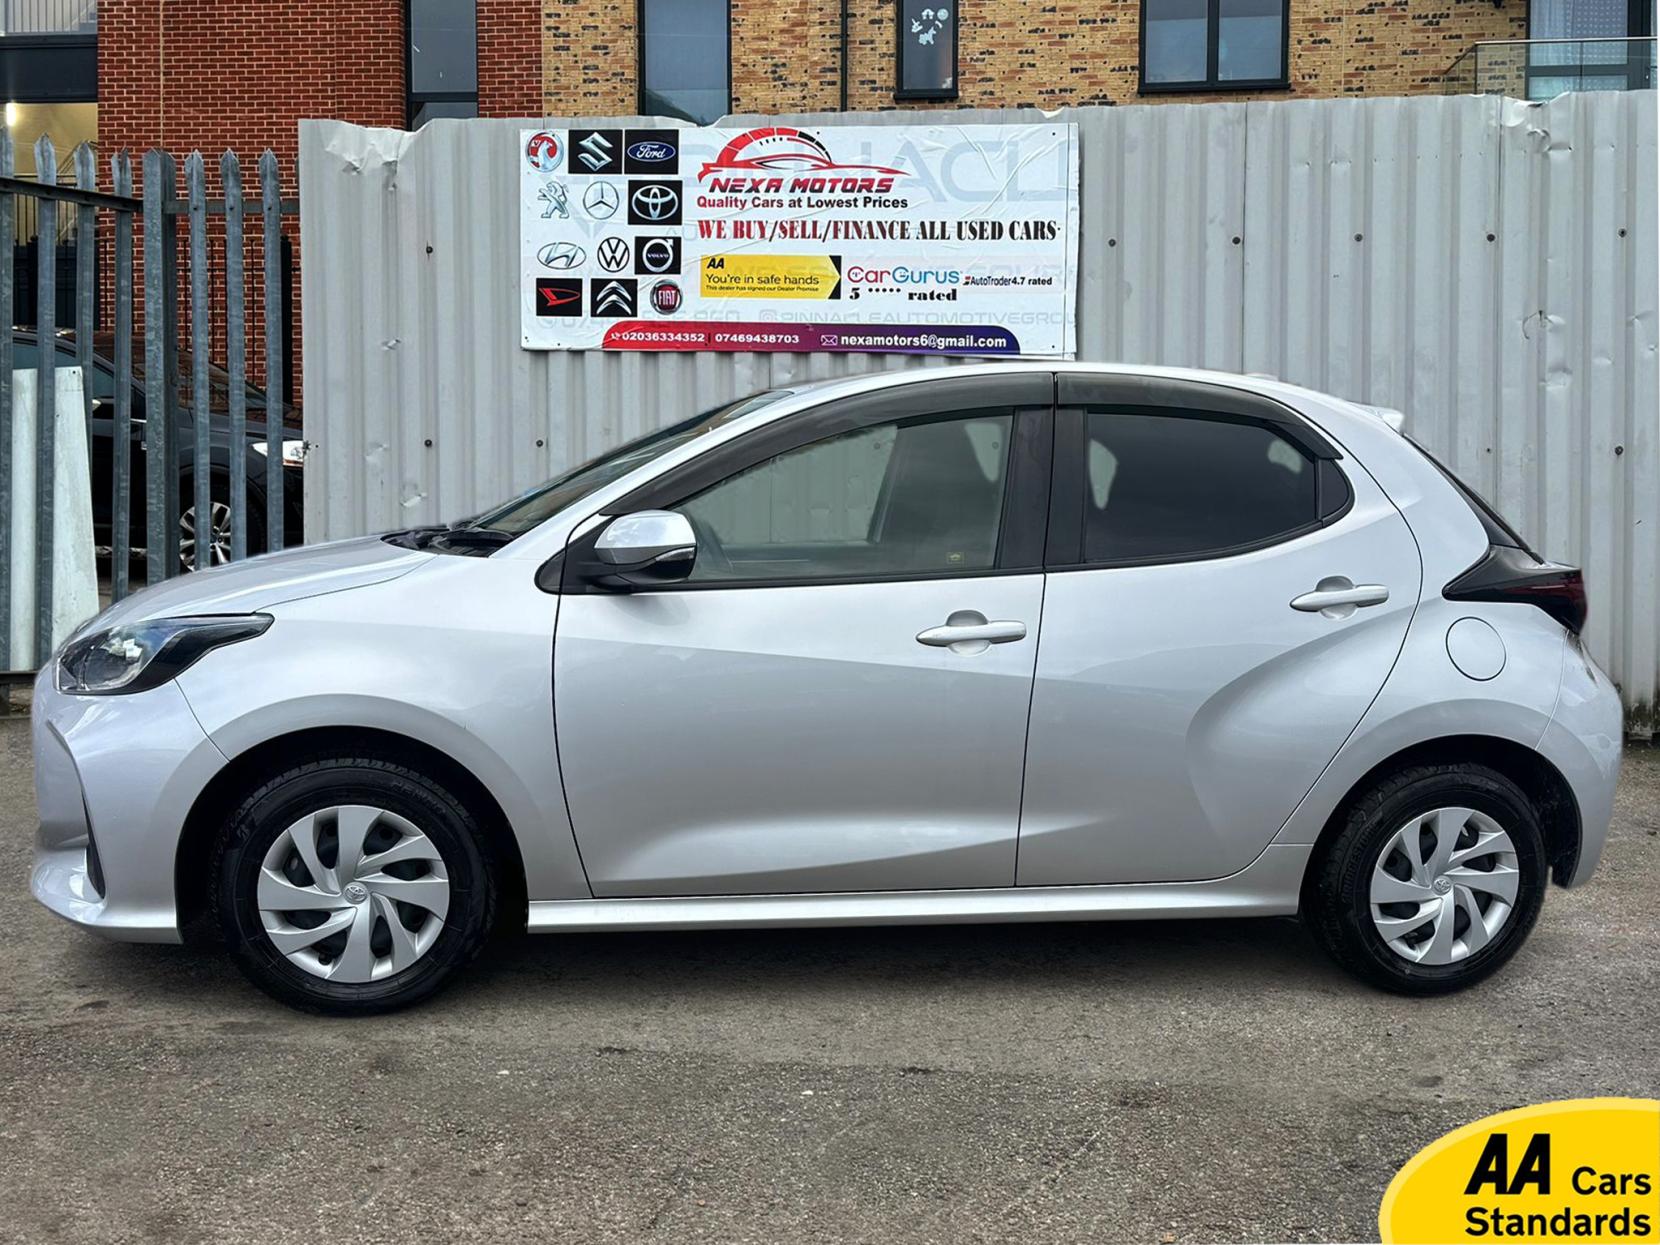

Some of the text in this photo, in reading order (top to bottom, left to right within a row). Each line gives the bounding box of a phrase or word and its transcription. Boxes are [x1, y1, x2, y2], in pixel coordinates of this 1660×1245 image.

[636, 144, 666, 159] Ford
[709, 178, 894, 194] NEXA MOTORS
[697, 196, 908, 210] Quality Cars at Lowest Prices
[697, 220, 727, 240] WE
[916, 220, 951, 241] ALL
[957, 221, 1004, 241] USED
[1009, 221, 1057, 241] CARS
[706, 258, 725, 269] AA
[706, 274, 820, 286] You're in safe hands
[847, 266, 960, 284] CarGurus
[1027, 276, 1053, 286] rated
[658, 291, 677, 305] FIAT
[849, 287, 957, 301] 5 rated
[622, 332, 800, 344] 02036334352 07469438703
[841, 335, 1007, 350] nexamotors6@gmail.com
